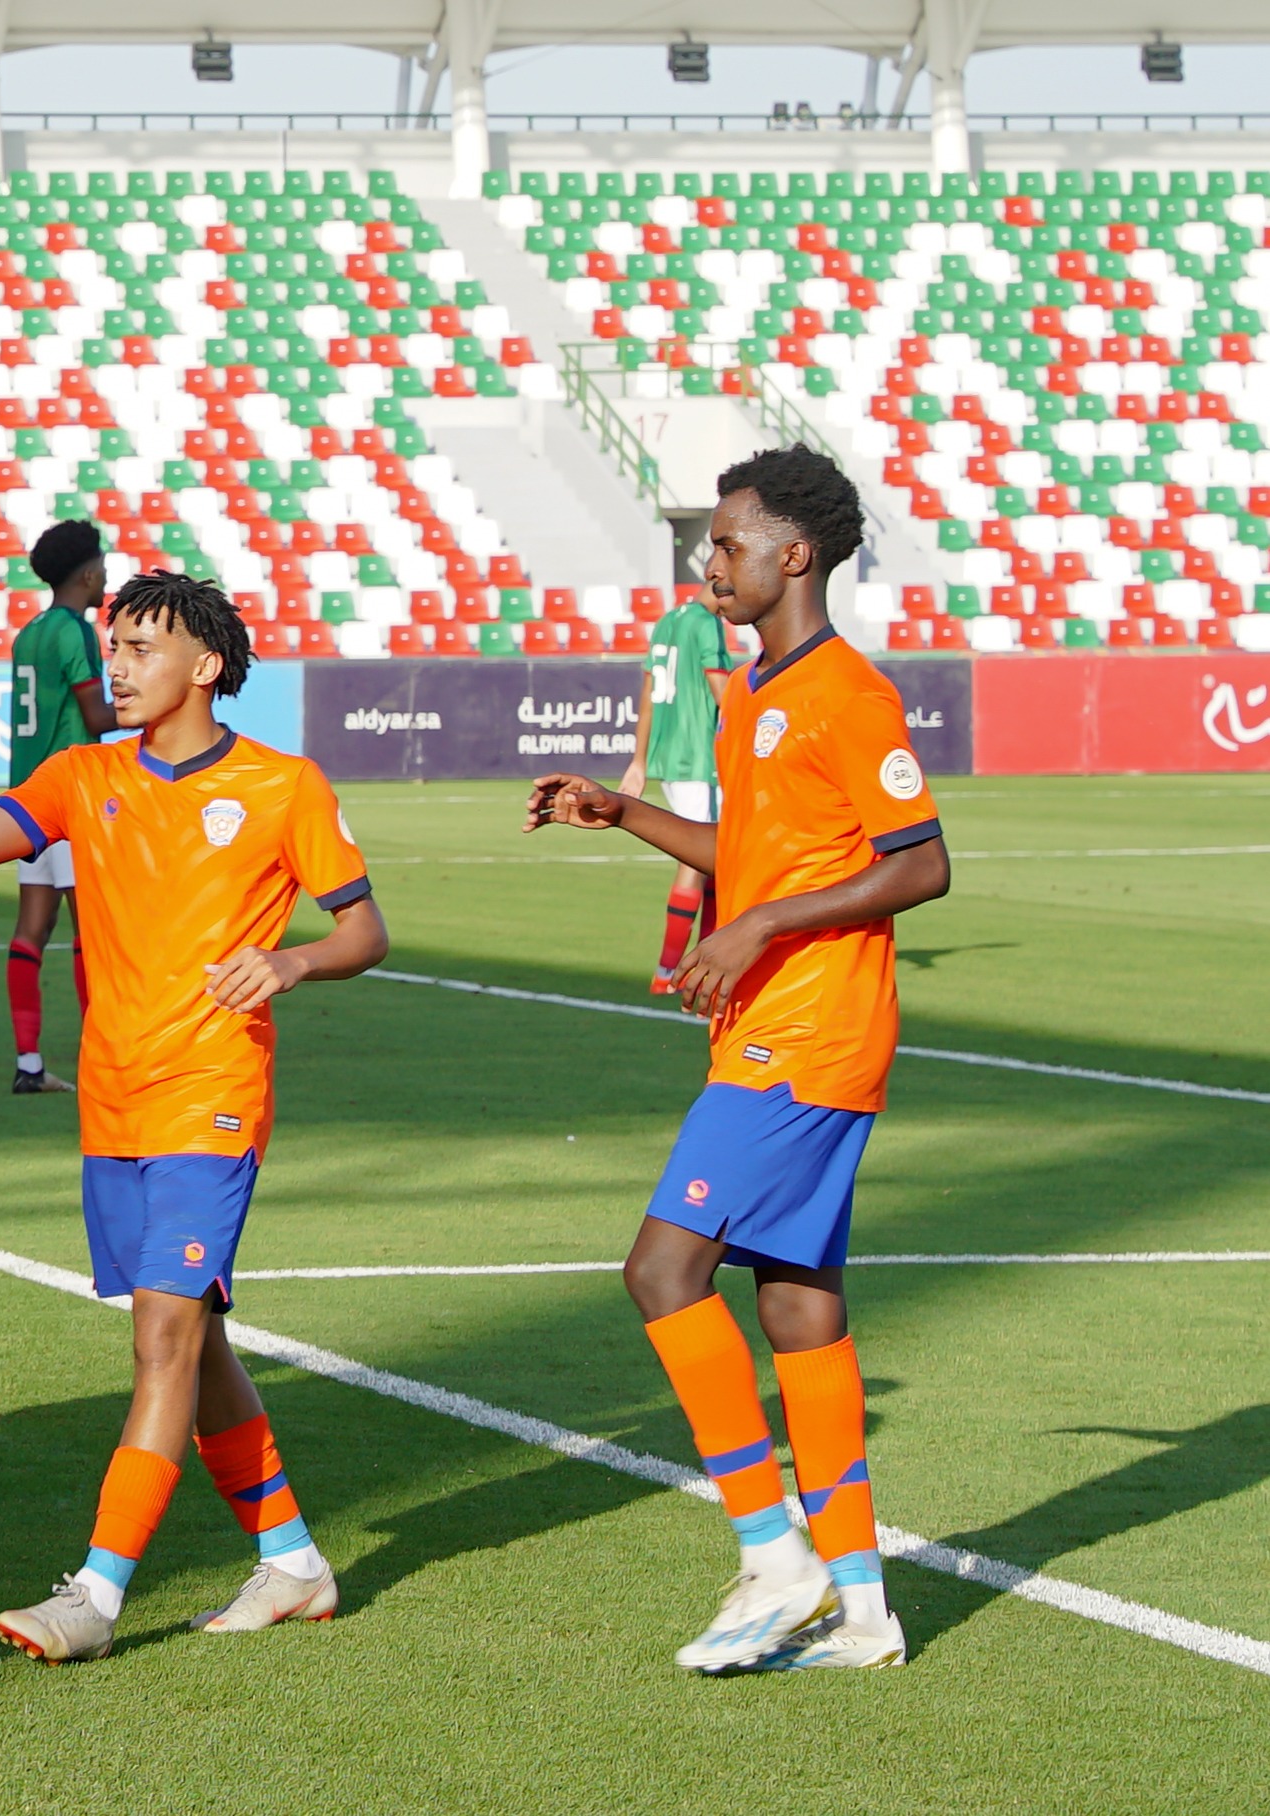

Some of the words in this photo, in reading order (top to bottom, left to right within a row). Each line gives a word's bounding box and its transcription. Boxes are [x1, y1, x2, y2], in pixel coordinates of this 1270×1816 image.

[636, 412, 669, 442] 17
[17, 665, 37, 736] 3
[517, 696, 611, 728] العربية
[344, 708, 442, 735] aldyar.sa
[518, 734, 586, 755] ALDYAR
[590, 734, 636, 755] ALAR
